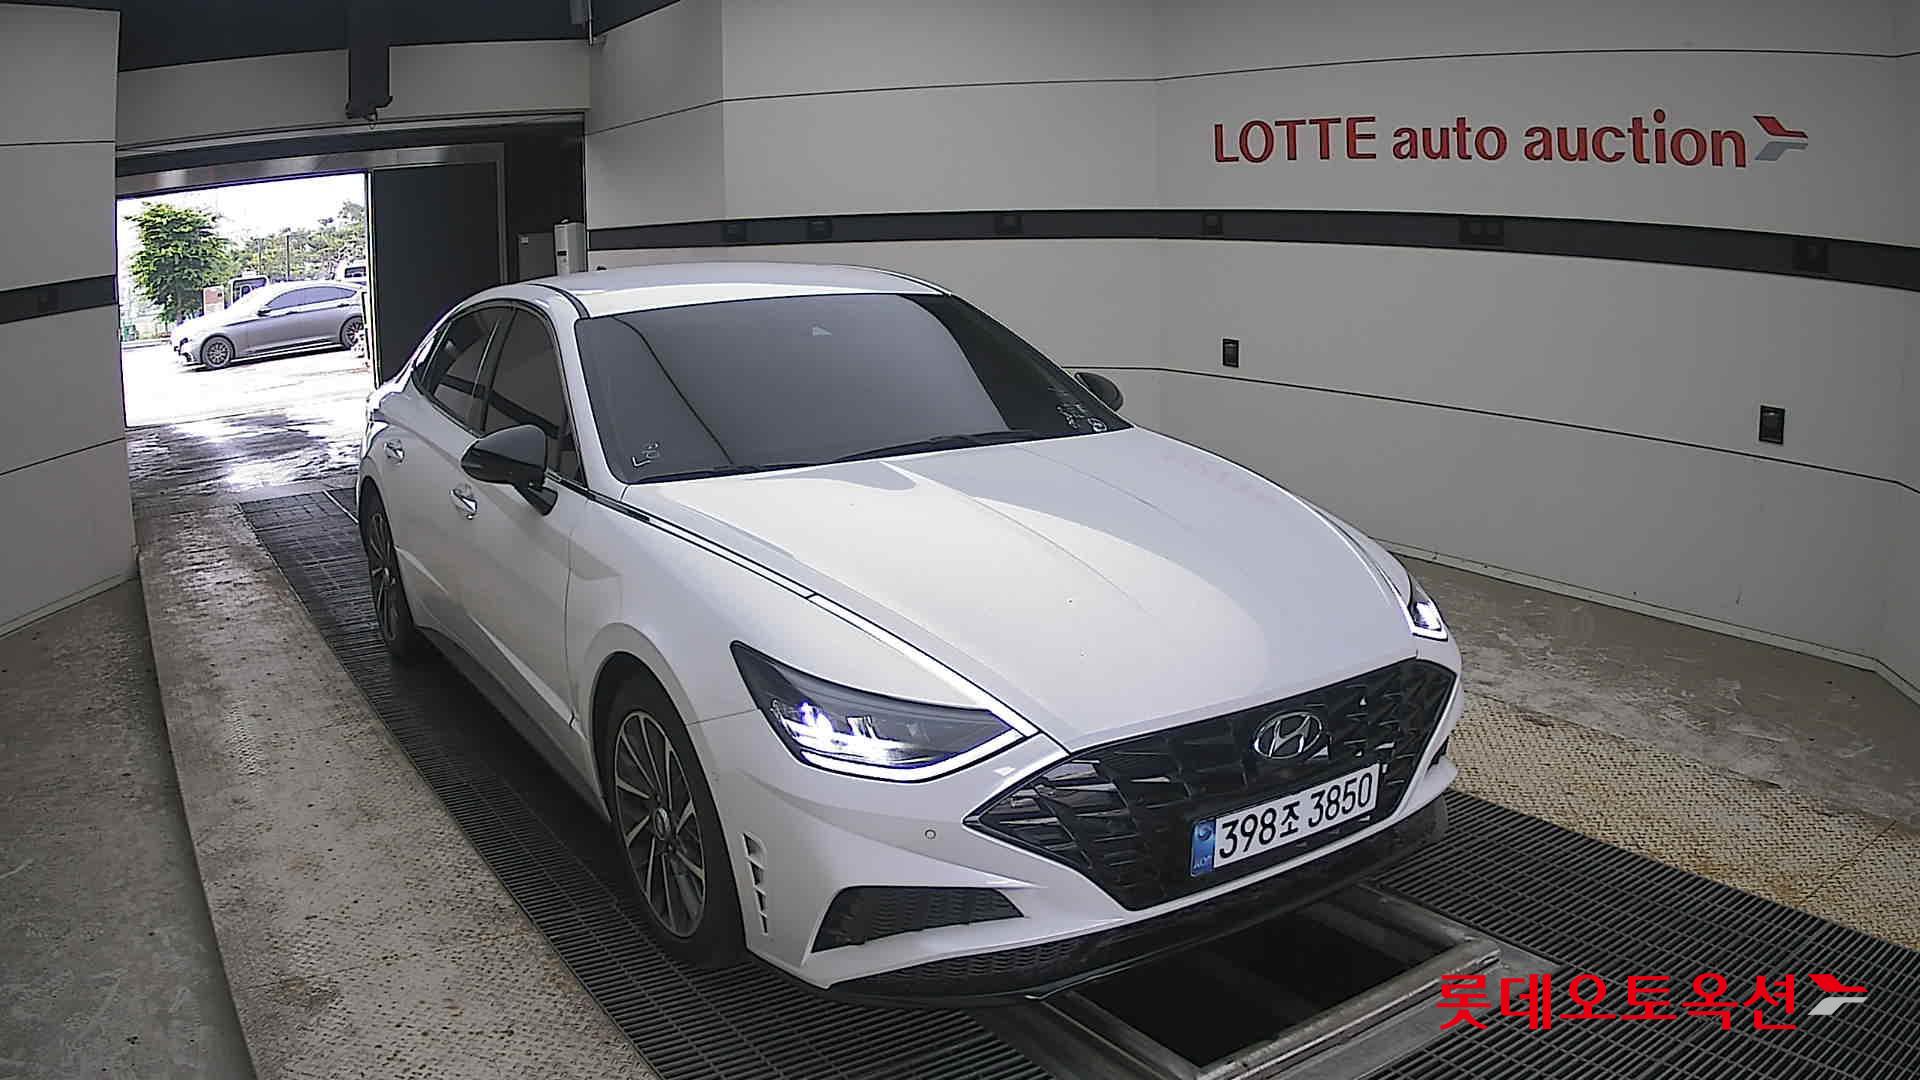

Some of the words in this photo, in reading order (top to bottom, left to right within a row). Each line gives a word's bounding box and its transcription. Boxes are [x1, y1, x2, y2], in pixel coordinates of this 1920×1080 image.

[1213, 115, 1377, 163] LOTTE
[1392, 116, 1507, 163] auto
[1523, 109, 1747, 168] auction
[1218, 801, 1301, 859] 398조
[1308, 772, 1374, 828] 3850
